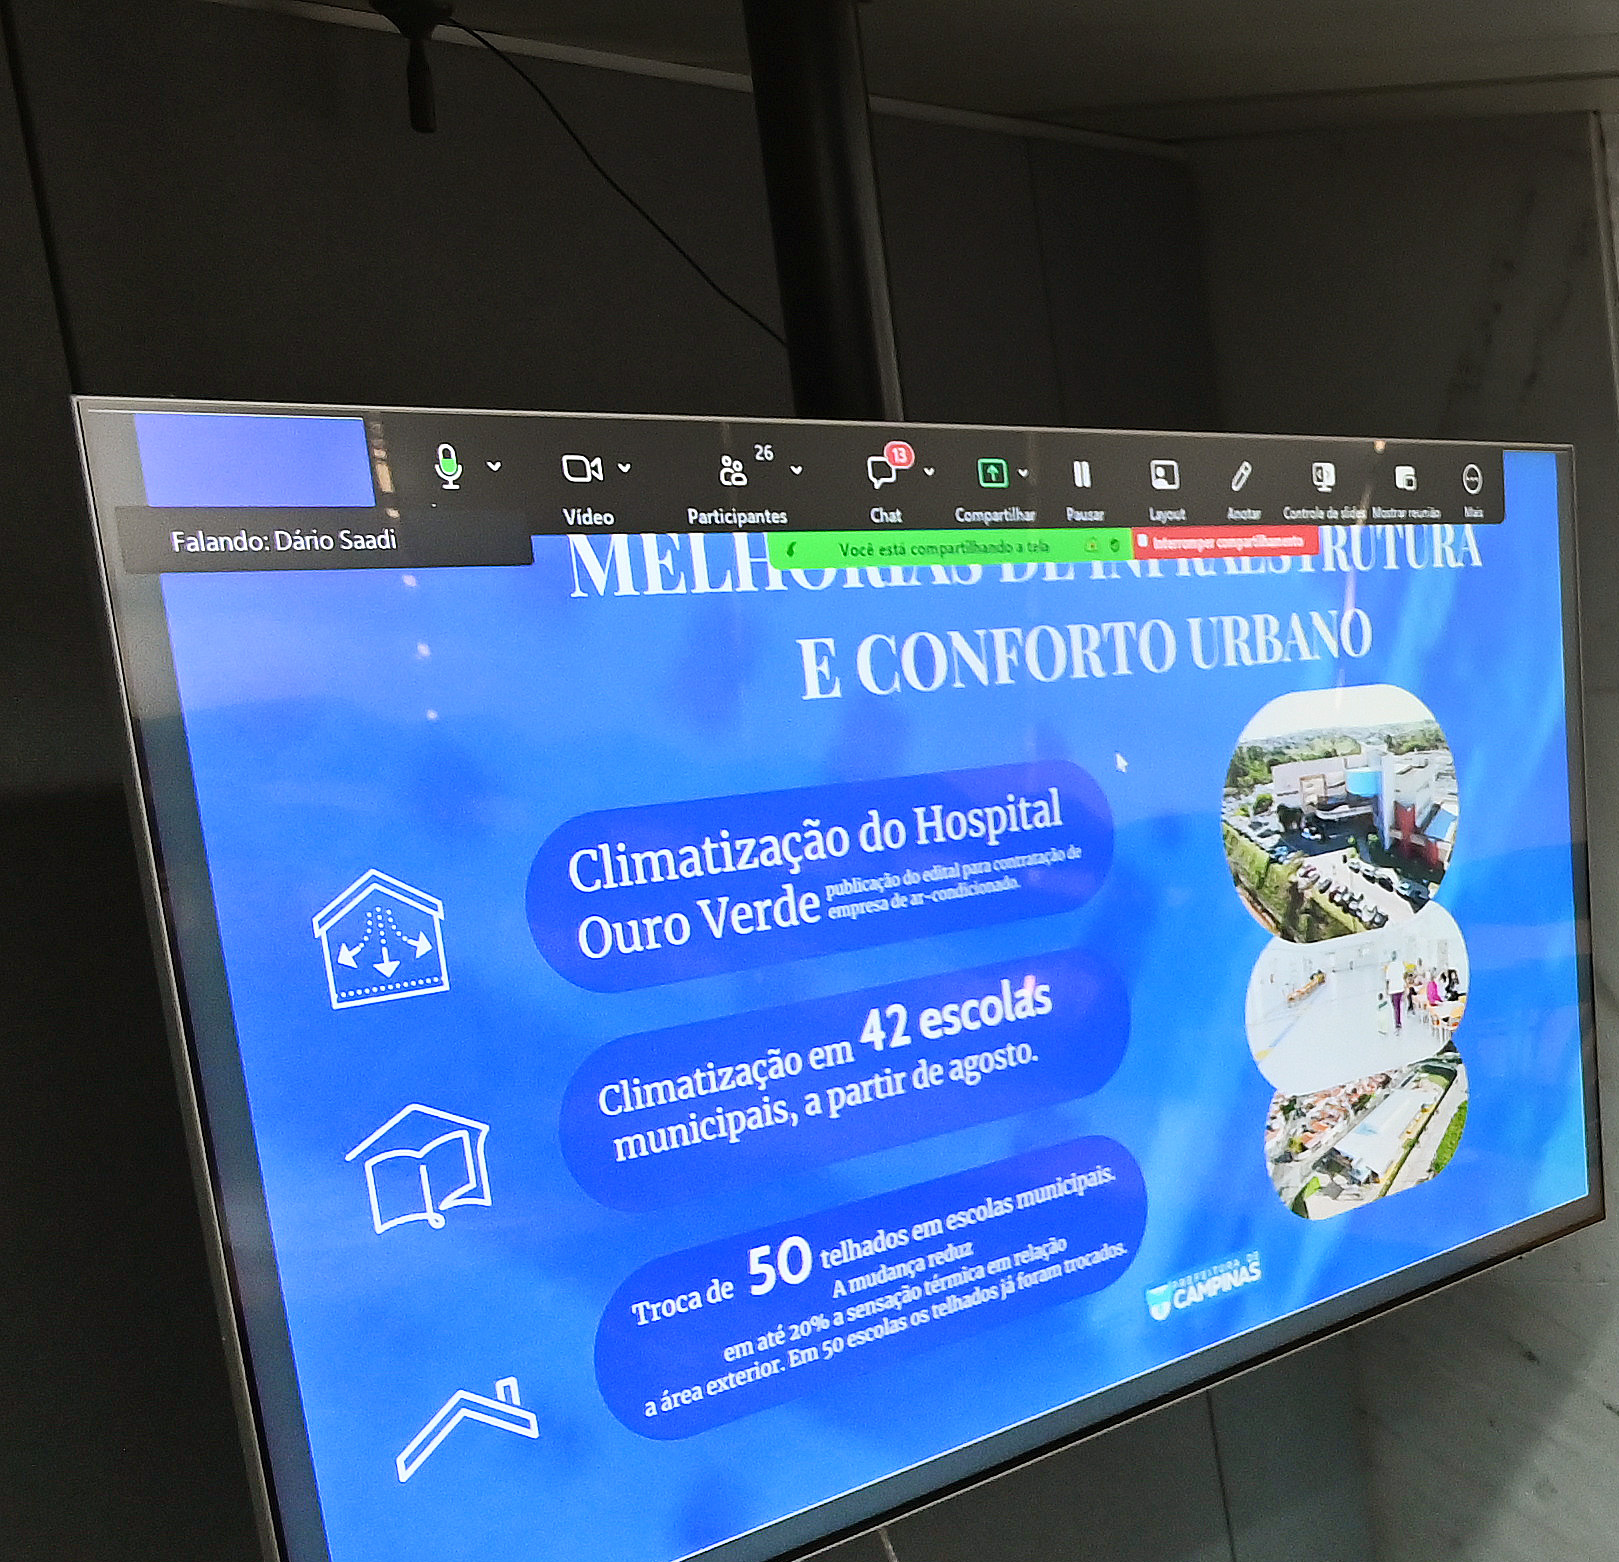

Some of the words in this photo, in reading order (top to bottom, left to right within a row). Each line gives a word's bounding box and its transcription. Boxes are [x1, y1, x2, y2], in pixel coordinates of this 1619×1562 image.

[754, 444, 774, 461] 26
[891, 447, 907, 464] 13
[562, 508, 615, 526] Vídeo
[687, 507, 788, 527] Participantes
[869, 507, 903, 524] Chat
[954, 507, 1037, 526] Compartilhar
[171, 530, 270, 554] Falando:
[274, 528, 335, 553] Dário
[339, 527, 397, 552] Saadi
[839, 542, 874, 557] Você
[879, 542, 906, 556] está
[797, 637, 842, 700] E
[856, 618, 1177, 696] CONFORTO
[1187, 607, 1374, 671] URBANO
[568, 817, 850, 893] Climatização
[858, 809, 906, 852] do
[914, 787, 1064, 847] Hospital
[824, 872, 901, 902] publicação
[903, 868, 921, 887] do
[922, 862, 961, 883] edital
[962, 860, 992, 880] para
[578, 907, 692, 959] Ouro
[696, 884, 822, 939] Verde
[827, 897, 890, 920] empresa
[890, 892, 909, 910] de
[598, 1047, 802, 1117] Climatização
[809, 1037, 856, 1072] em
[859, 1002, 911, 1052] 42
[919, 978, 1053, 1038] escolas
[613, 1096, 799, 1162] municipais,
[804, 1096, 823, 1118] a
[827, 1065, 907, 1119] partir
[912, 1056, 945, 1089] de
[949, 1039, 1039, 1087] agosto.
[631, 1290, 703, 1326] Troca
[706, 1278, 735, 1304] de
[748, 1235, 812, 1296] 50
[820, 1228, 909, 1269] telhados
[911, 1217, 944, 1241] em
[946, 1196, 1014, 1231] escolas
[1015, 1165, 1116, 1210] municipais.
[832, 1279, 847, 1298] A
[848, 1256, 926, 1294] mudança
[1173, 1261, 1262, 1309] CAMPINAS
[723, 1339, 754, 1362] em
[757, 1323, 786, 1352] até
[789, 1312, 831, 1342] 20%
[832, 1310, 845, 1327] a
[846, 1284, 923, 1322] sensação
[924, 1264, 985, 1296] térmica
[987, 1255, 1012, 1275] em
[1013, 1236, 1068, 1267] relação
[644, 1399, 658, 1418] a
[660, 1384, 704, 1414] área
[706, 1358, 786, 1397] exterior.
[787, 1344, 819, 1369] Em
[822, 1335, 845, 1361] 50
[847, 1312, 908, 1348] escolas
[910, 1308, 931, 1327] os
[932, 1284, 999, 1320] telhados
[1000, 1274, 1016, 1301] já
[1017, 1264, 1062, 1290] foram
